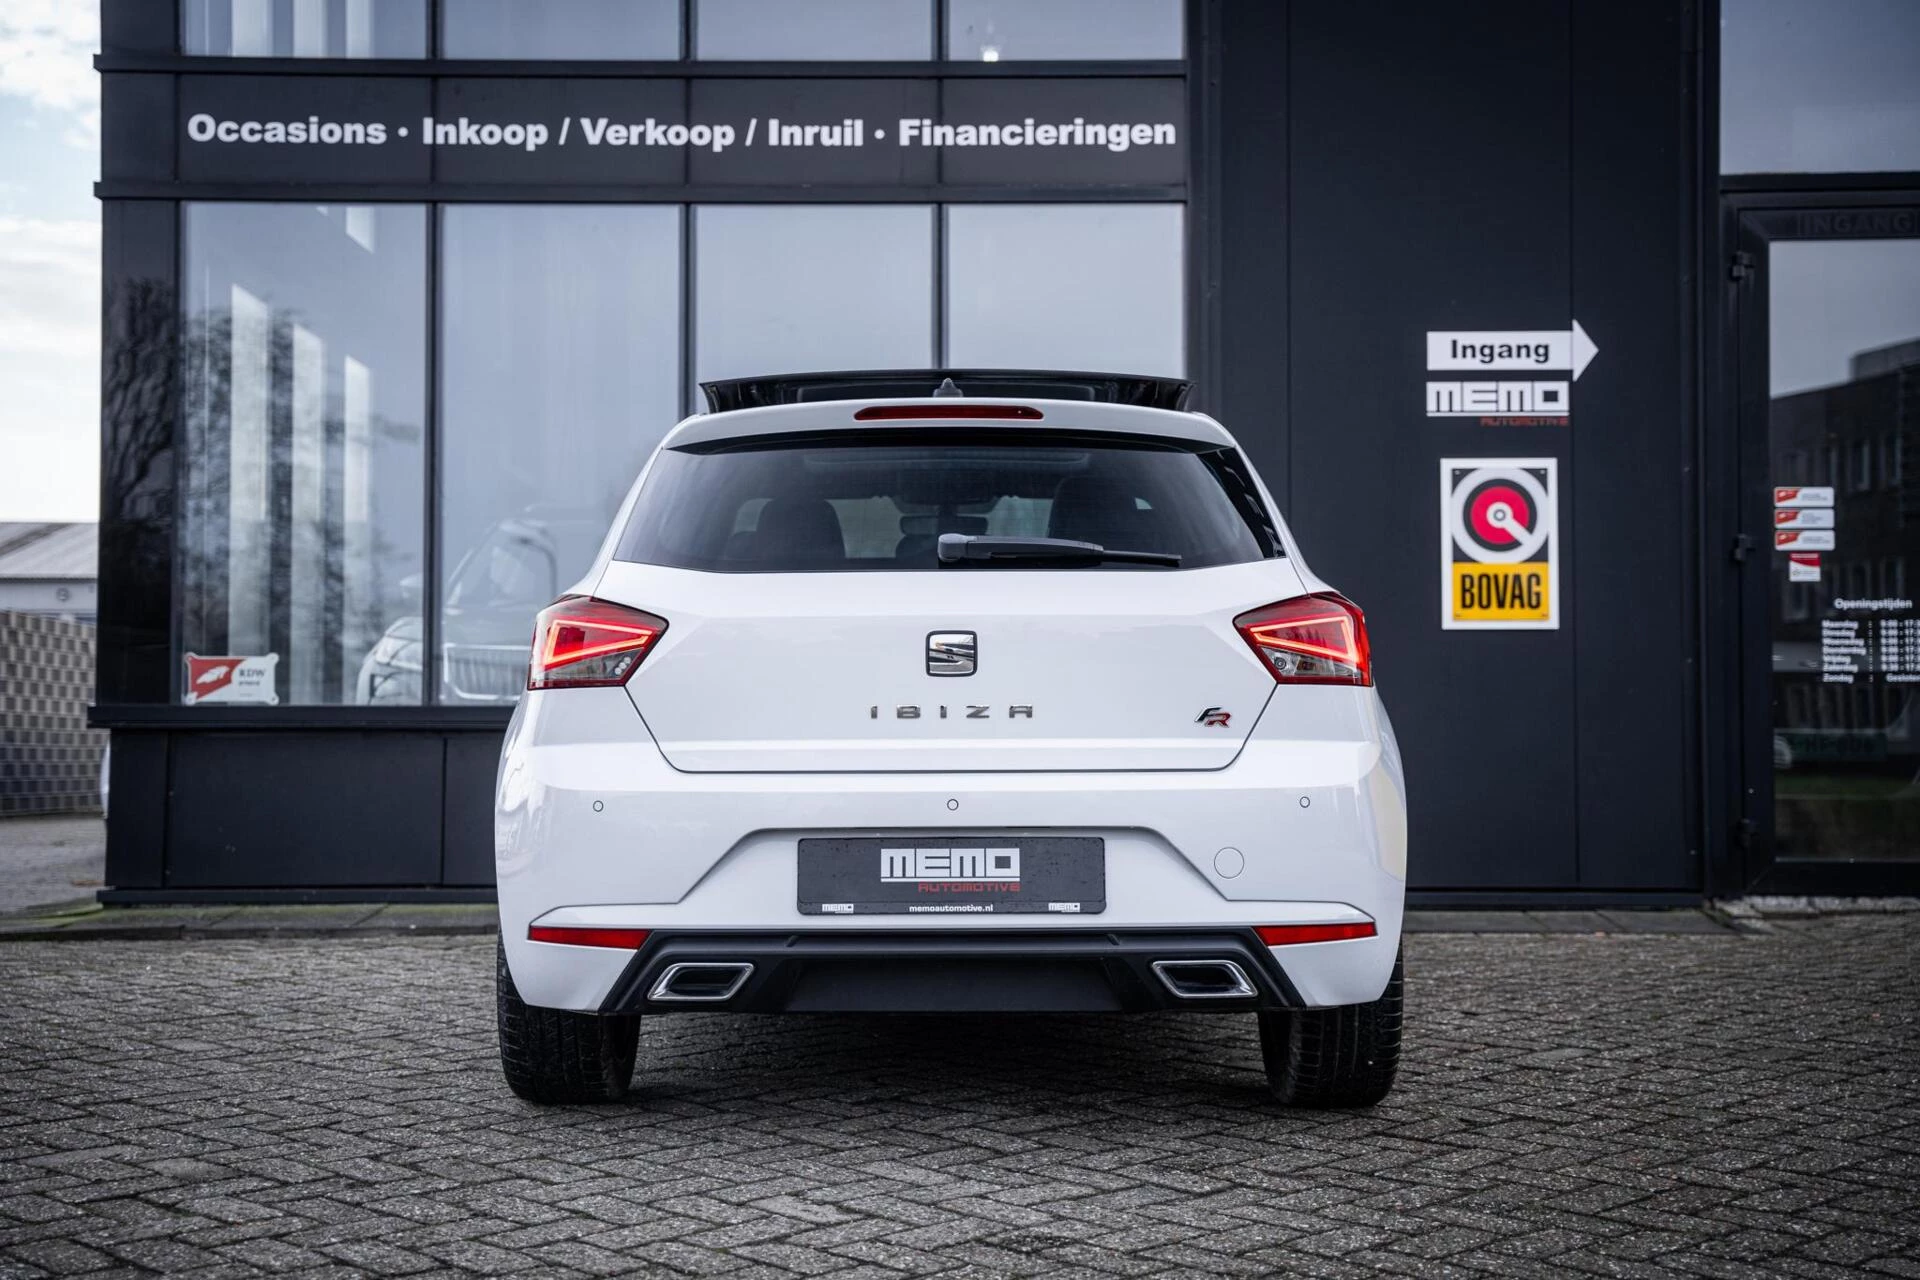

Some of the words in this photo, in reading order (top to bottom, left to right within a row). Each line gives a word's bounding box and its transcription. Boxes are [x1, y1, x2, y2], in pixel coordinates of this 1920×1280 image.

[187, 113, 388, 145] Occasions
[422, 117, 549, 152] Inkoop
[579, 117, 736, 153] Verkoop
[768, 118, 864, 147] Inruil
[899, 117, 1177, 152] Financieringen
[1451, 339, 1550, 364] Ingang
[1426, 381, 1569, 413] MEMO
[1460, 573, 1541, 610] BOVAG
[1833, 597, 1913, 611] Openingstijden
[870, 704, 1034, 720] IBIZA
[1194, 706, 1231, 728] FR
[880, 848, 1021, 882] MEMO
[918, 882, 1021, 893] AUTOMOTIVE
[909, 903, 994, 913] memoautomotive.nl
